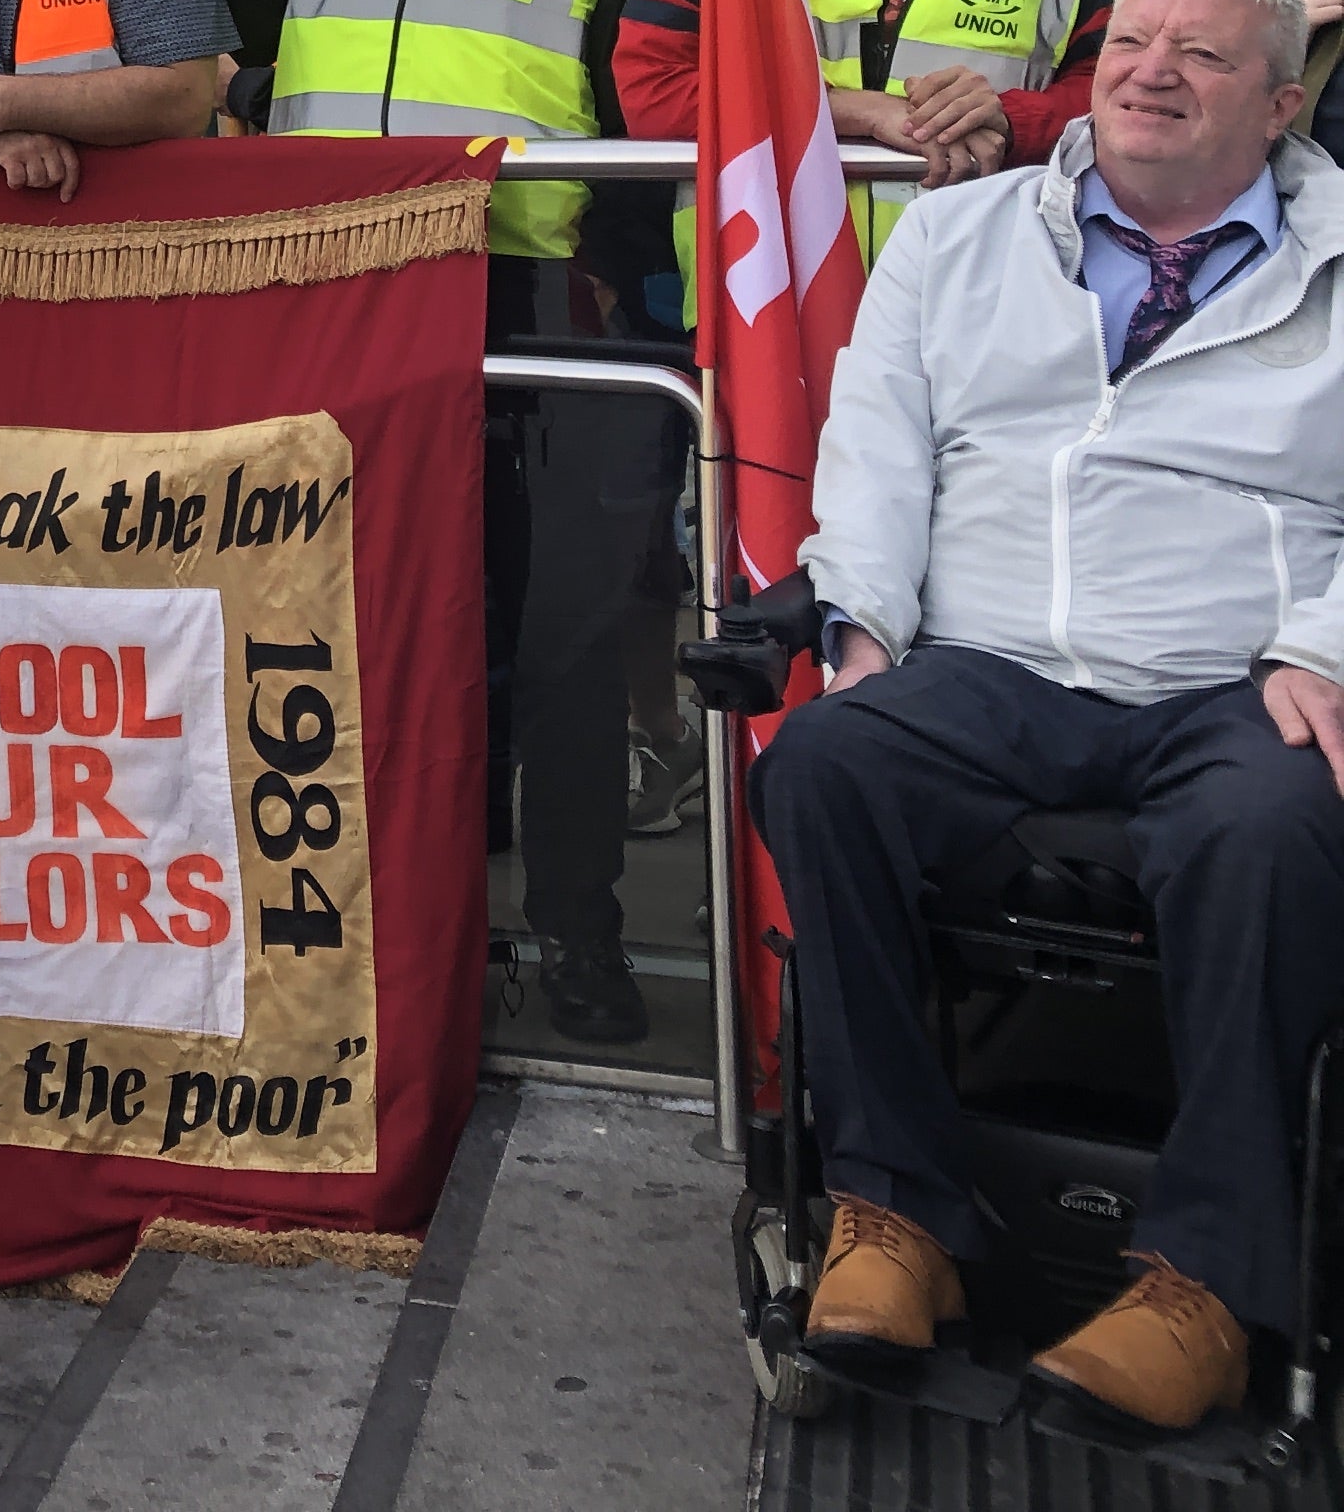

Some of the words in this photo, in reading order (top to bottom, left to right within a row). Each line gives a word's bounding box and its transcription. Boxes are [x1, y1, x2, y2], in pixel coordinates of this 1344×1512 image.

[954, 12, 1018, 39] UNION
[101, 471, 205, 557] the
[215, 462, 352, 556] law
[244, 630, 344, 958] 1984
[23, 1036, 146, 1125] the
